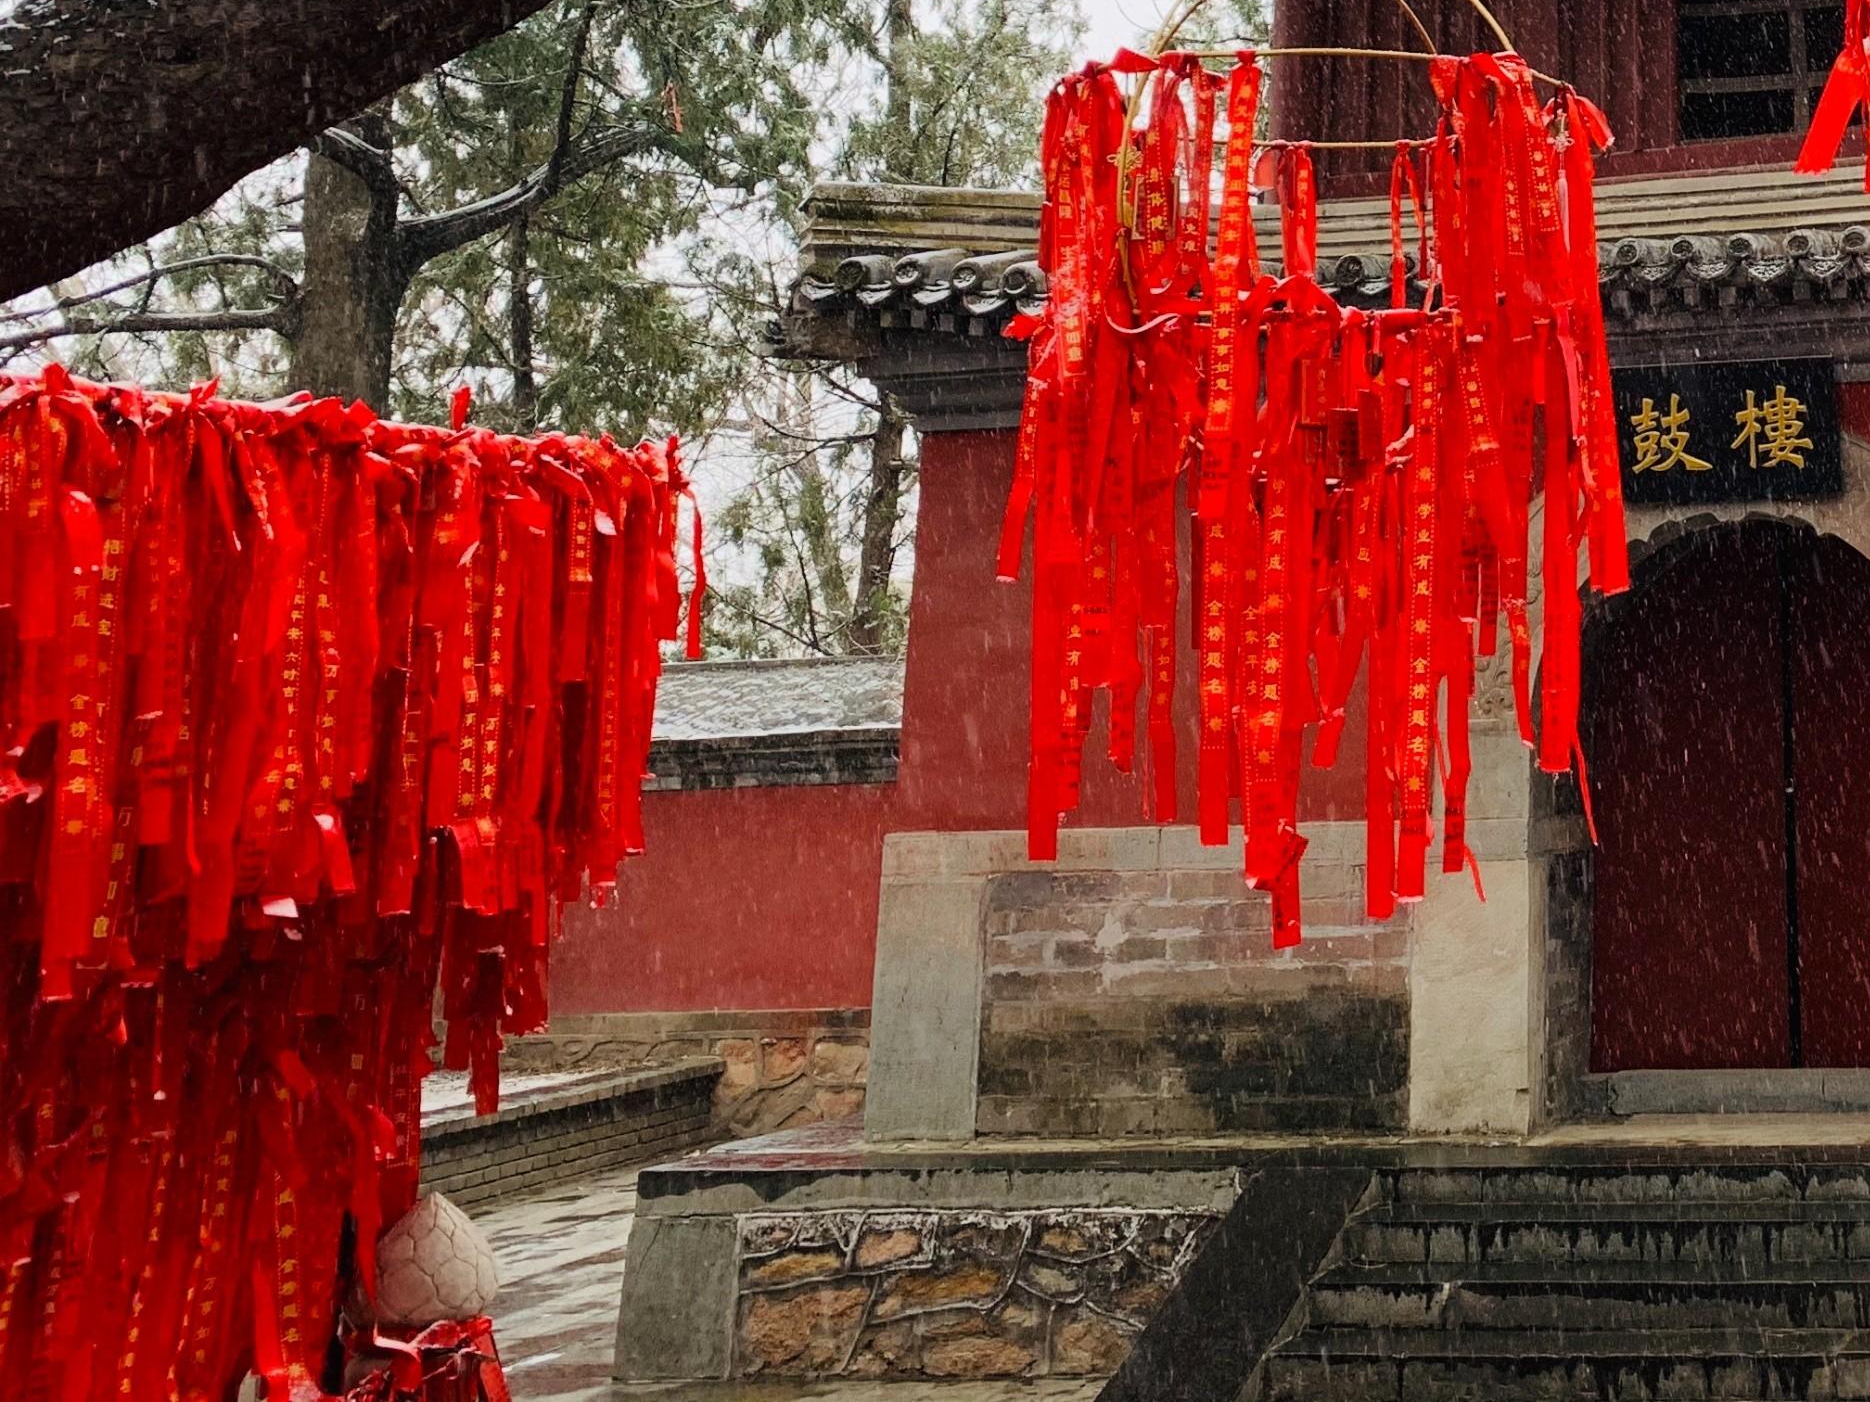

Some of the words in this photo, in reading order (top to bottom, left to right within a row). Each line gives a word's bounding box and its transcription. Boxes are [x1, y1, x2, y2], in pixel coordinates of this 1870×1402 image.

[1631, 385, 1814, 475] 鼓樓
[98, 539, 121, 635] 招财进宝
[1415, 503, 1432, 596] 学业有成
[1206, 600, 1226, 694] 金榜题名
[1262, 632, 1281, 726] 金榜题名
[69, 693, 91, 794] 金榜题名
[1408, 658, 1428, 754] 金榜题名
